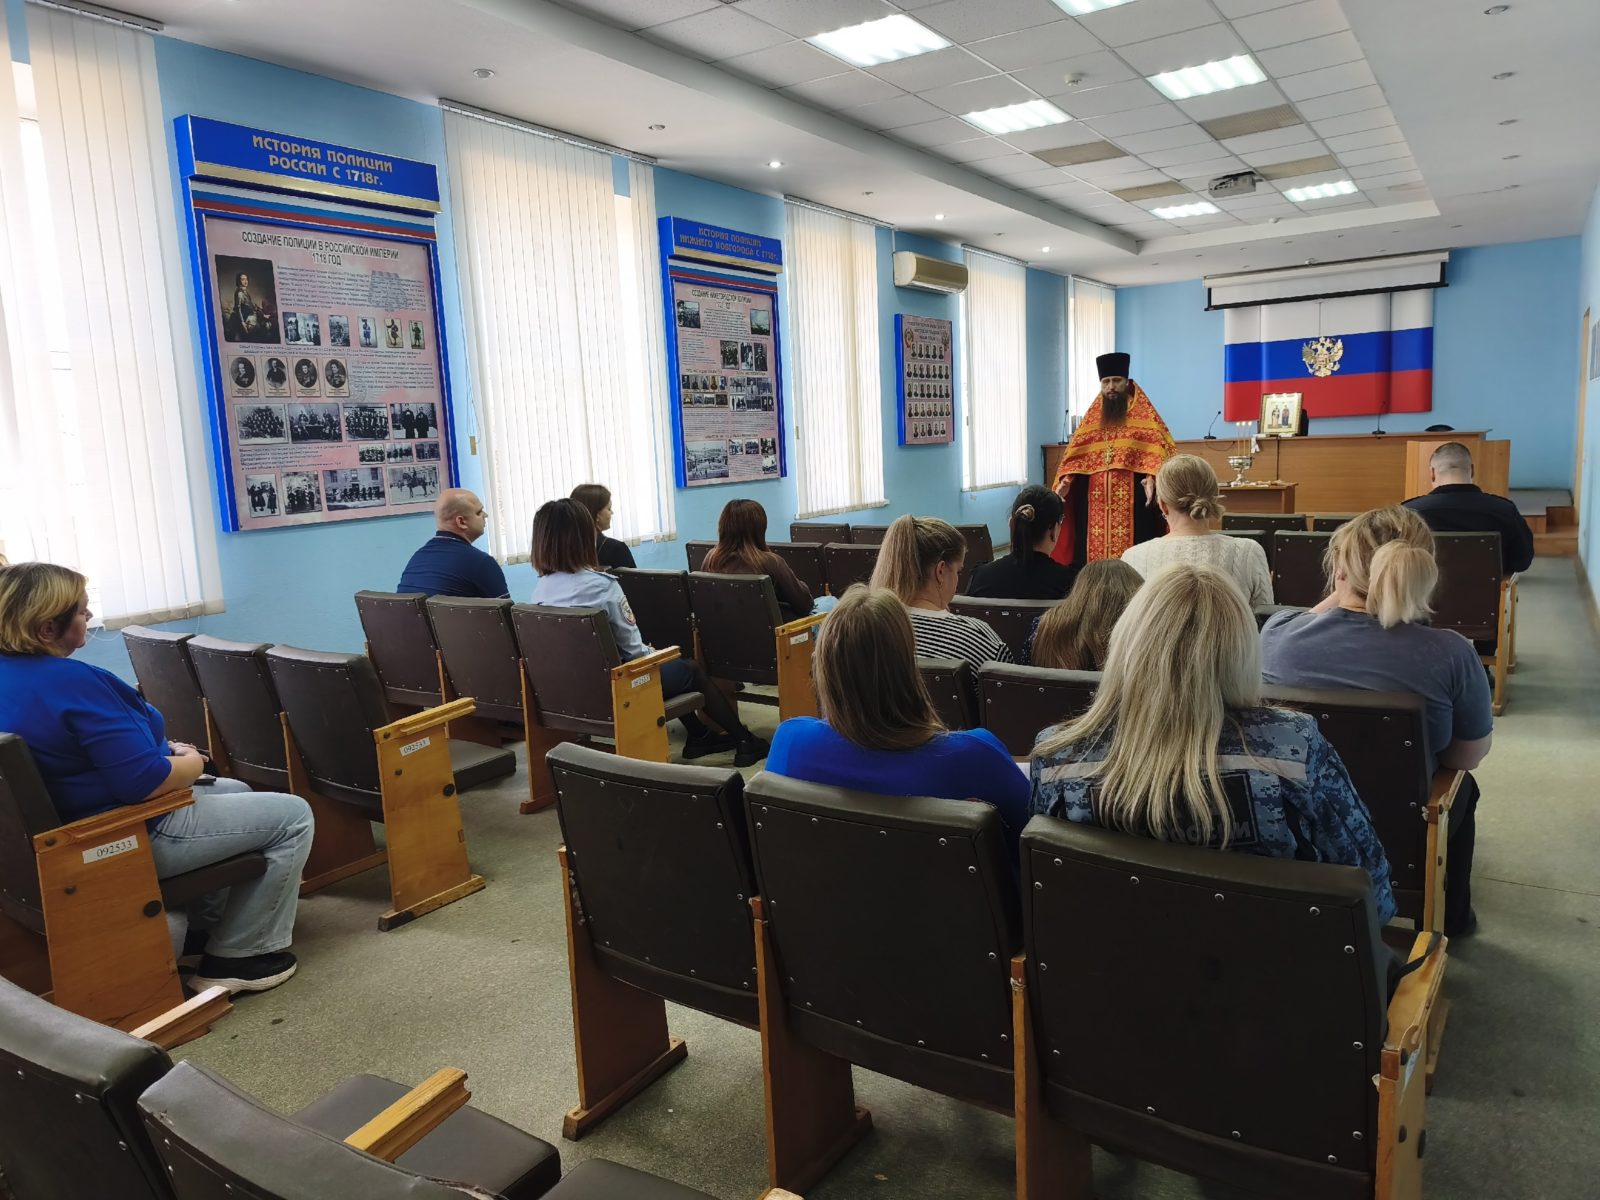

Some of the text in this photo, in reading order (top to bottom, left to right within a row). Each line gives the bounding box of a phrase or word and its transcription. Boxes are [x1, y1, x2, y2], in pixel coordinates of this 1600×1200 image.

[252, 135, 393, 173] ИСТОРИЯ ПОЛИЦИИ
[269, 155, 383, 186] РОССИИ С 1718г.
[698, 227, 729, 241] ИСТОРИЯ
[241, 231, 399, 260] СОЗДАНИЕ ПОЛИЦИИ В РОССИЙСКОЙ ИМПЕРИИ
[715, 241, 754, 256] НОВГОРОДА
[312, 252, 342, 266] 1718 ГОД
[96, 840, 133, 858] 092533
